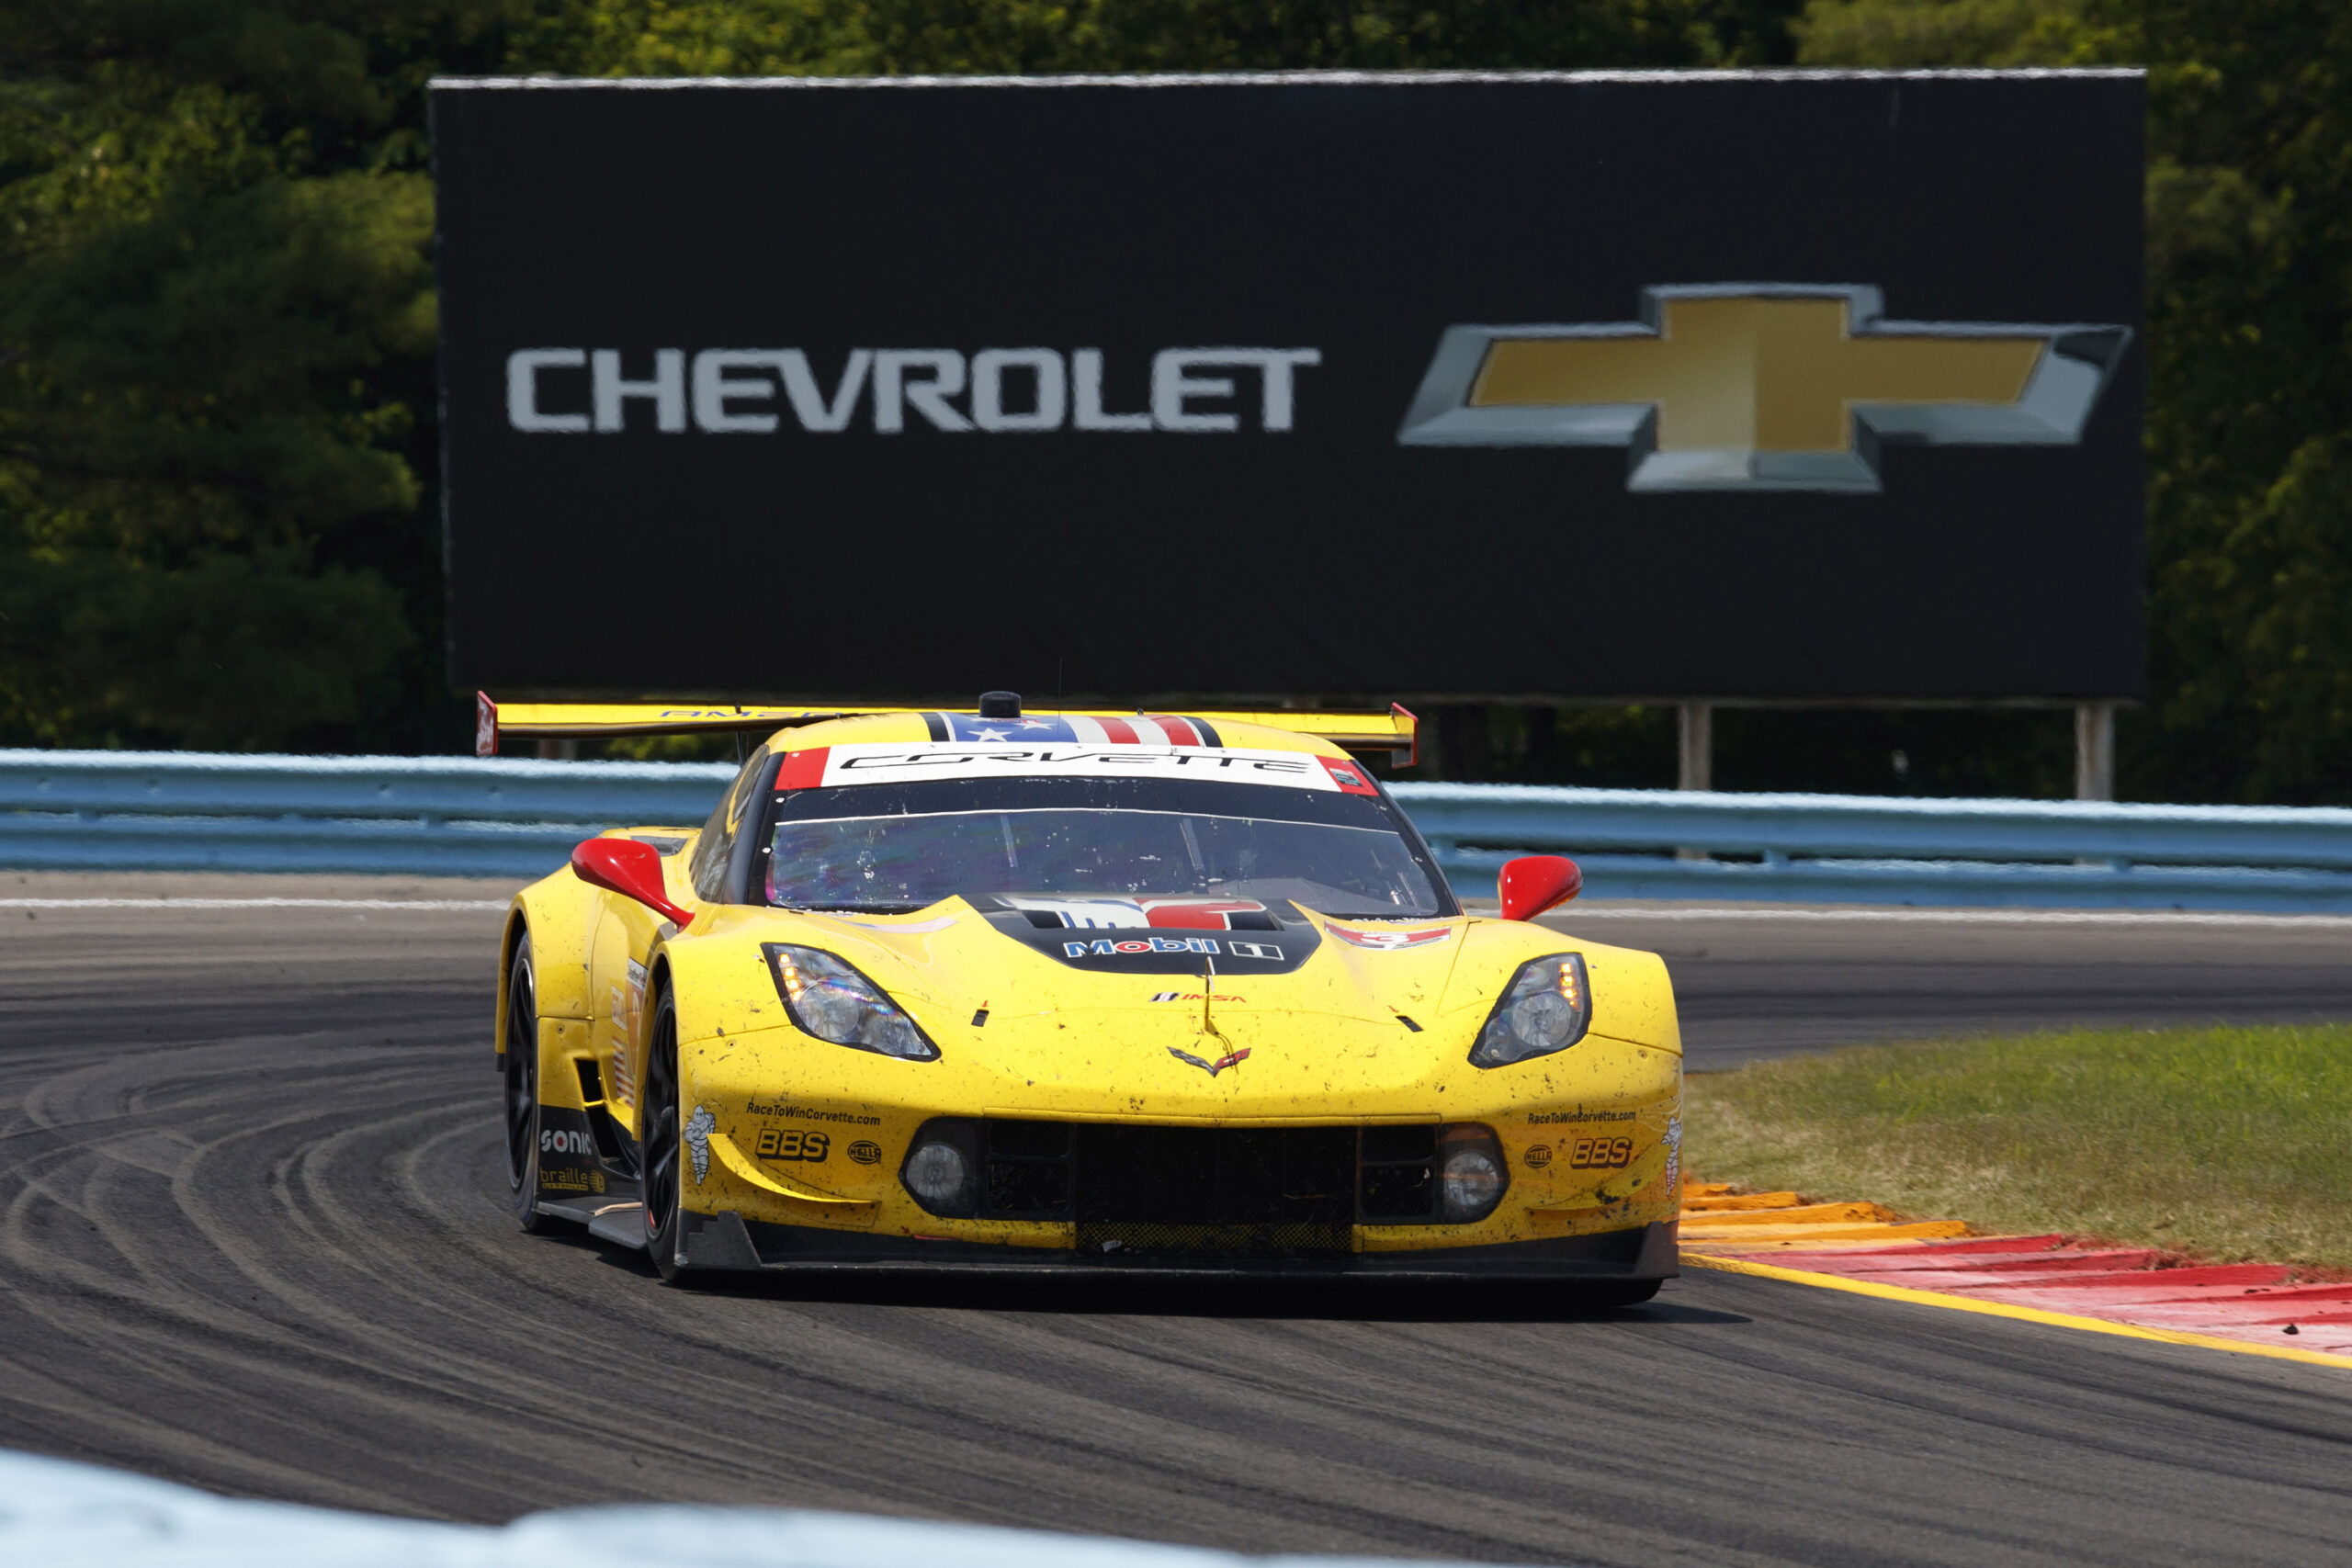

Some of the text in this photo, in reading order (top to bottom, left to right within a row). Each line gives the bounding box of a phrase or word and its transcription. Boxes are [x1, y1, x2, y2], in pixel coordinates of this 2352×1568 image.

[505, 347, 1321, 434] CHEVROLET
[840, 752, 1310, 773] CORVETTE
[1063, 937, 1220, 958] Mobil
[1360, 932, 1410, 944] 3
[1182, 994, 1246, 1003] IMSA
[746, 1102, 881, 1126] RaceToWinCorvette.com
[1528, 1111, 1636, 1125] RaceToWinCorvette.com
[755, 1128, 831, 1163] BBS
[850, 1146, 881, 1159] HELLA
[1570, 1136, 1633, 1169] BBS
[1525, 1150, 1553, 1162] HELLA
[539, 1167, 588, 1184] braille
